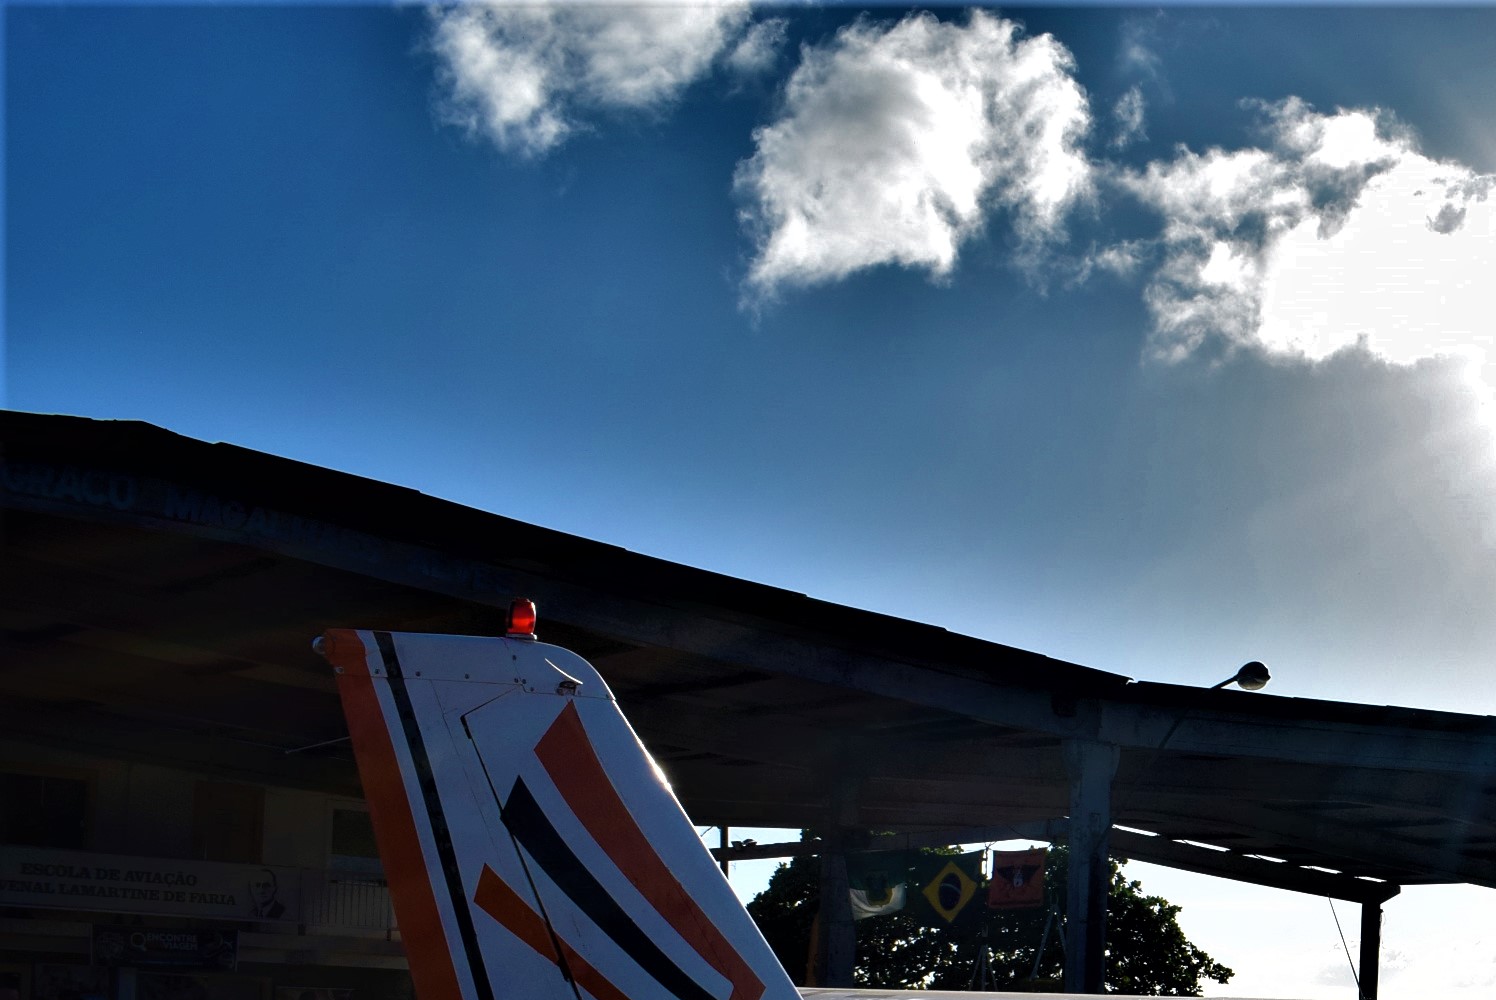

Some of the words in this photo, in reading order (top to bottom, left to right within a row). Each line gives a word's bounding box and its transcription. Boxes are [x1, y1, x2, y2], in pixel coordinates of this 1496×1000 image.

[20, 862, 91, 880] ESCOLA
[95, 866, 121, 882] DE
[123, 869, 198, 888] AVIAÇÃO
[58, 883, 160, 901] LAMARTINE
[163, 890, 186, 903] DE
[188, 892, 237, 906] FARIA
